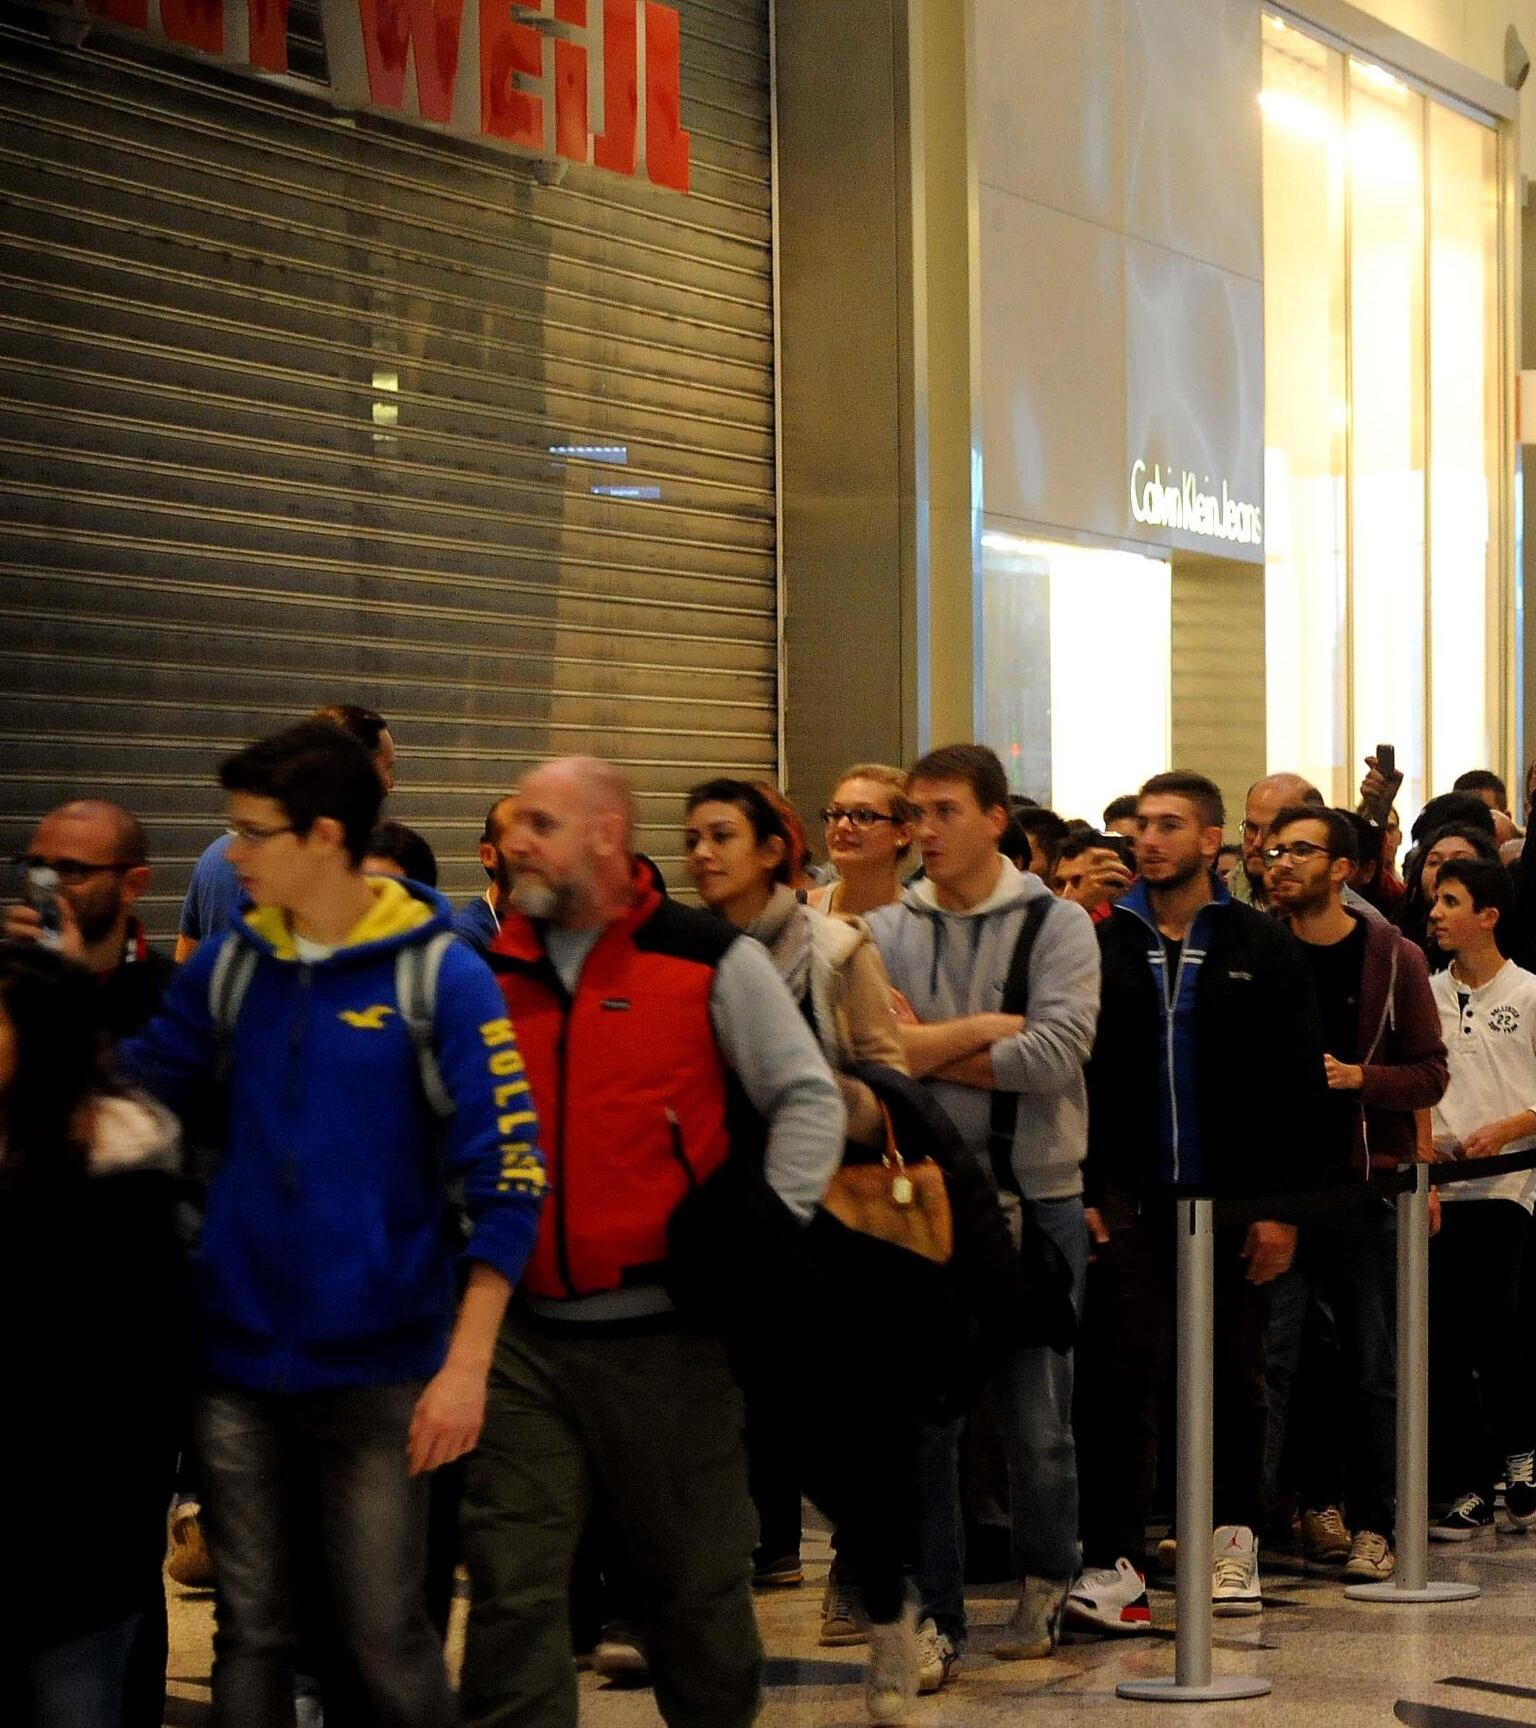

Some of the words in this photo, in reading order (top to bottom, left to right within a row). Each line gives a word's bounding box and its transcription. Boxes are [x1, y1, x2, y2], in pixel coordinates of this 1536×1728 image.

[1131, 459, 1183, 529] Calvin
[1182, 470, 1219, 536] Klein
[1216, 479, 1262, 545] Jeans
[1496, 1014, 1512, 1026] 22
